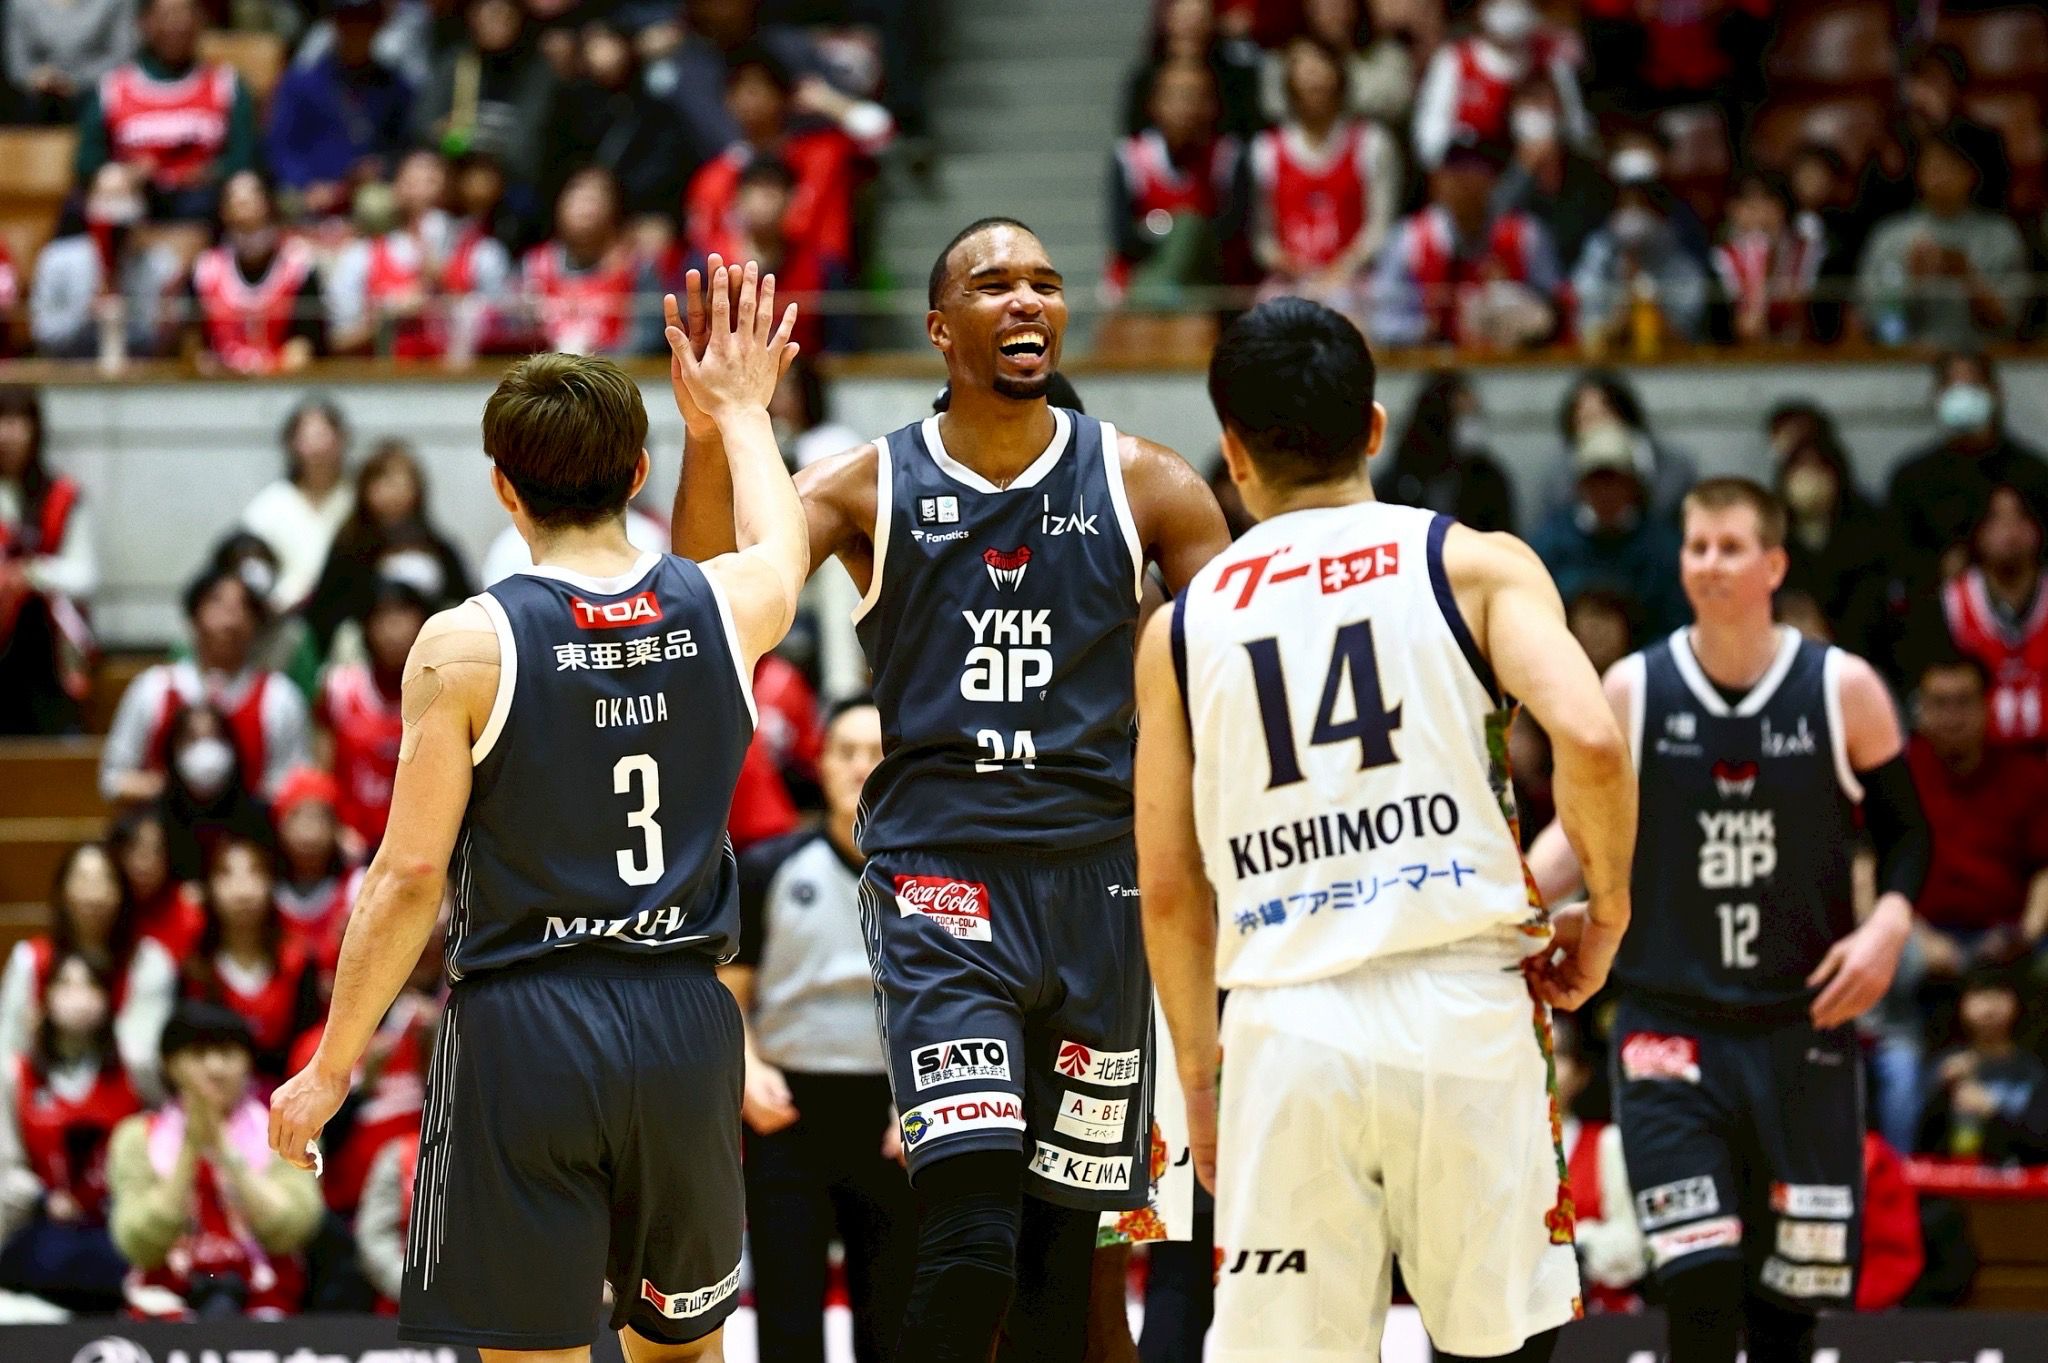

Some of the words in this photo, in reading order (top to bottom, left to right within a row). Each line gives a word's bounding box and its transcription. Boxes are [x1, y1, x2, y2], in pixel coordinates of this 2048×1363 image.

[926, 530, 970, 543] Fanatics
[576, 597, 658, 623] TOA
[961, 609, 1052, 645] YKK
[552, 629, 699, 672] 東亜薬品
[595, 691, 669, 728] OKADA
[1241, 618, 1403, 791] 14
[974, 728, 1038, 774] 24
[612, 752, 666, 887] 3
[1228, 792, 1460, 880] KISHIMOTO
[1697, 809, 1776, 841] YKK
[900, 879, 982, 914] Coca-Cola
[936, 915, 978, 928] COCA-COLA
[1715, 903, 1760, 968] 12
[917, 1041, 1005, 1076] SATO
[1062, 1157, 1127, 1184] KEIMA
[1229, 1249, 1308, 1274] JTA
